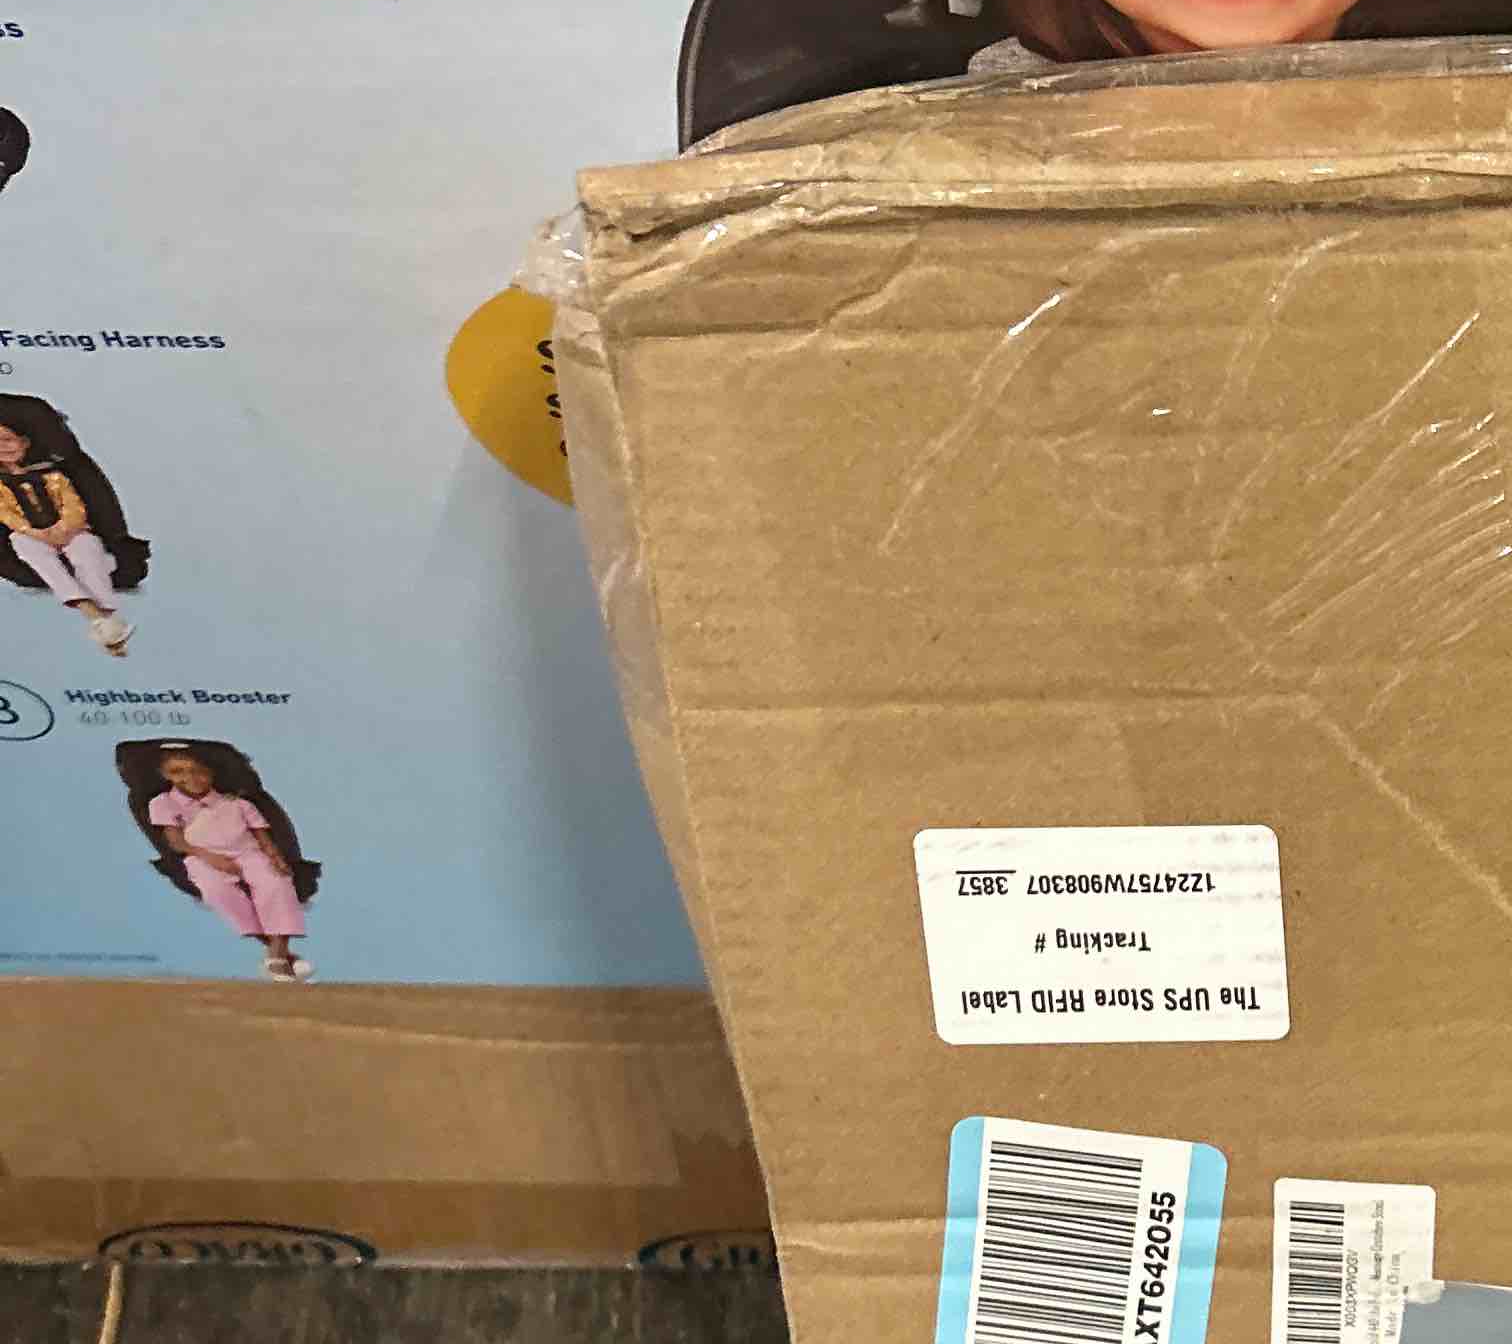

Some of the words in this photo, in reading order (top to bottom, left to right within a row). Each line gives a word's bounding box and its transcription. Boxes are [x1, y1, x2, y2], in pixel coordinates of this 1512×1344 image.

[0, 330, 97, 353] Facing
[101, 330, 226, 349] Harness
[64, 688, 187, 707] Highback
[191, 689, 292, 706] Booster
[957, 875, 1010, 897] 3857
[1026, 871, 1216, 895] 1Z24757W908307
[1034, 932, 1046, 953] #
[1055, 927, 1152, 955] Tracking
[961, 989, 1021, 1015] Label
[1031, 988, 1085, 1013] RFID
[1094, 988, 1154, 1012] Store
[1162, 987, 1210, 1011] UPS
[1220, 986, 1260, 1010] The
